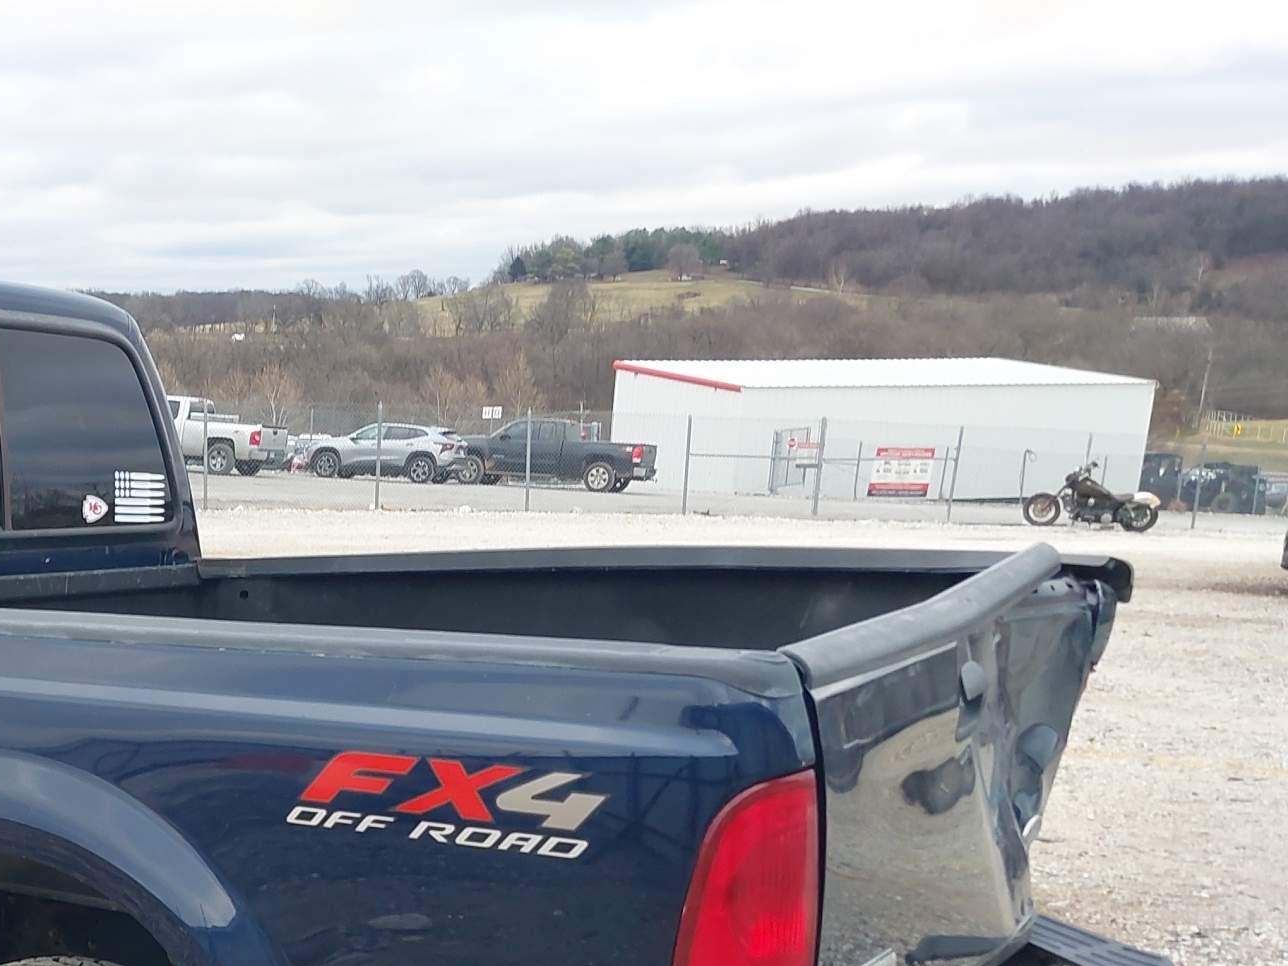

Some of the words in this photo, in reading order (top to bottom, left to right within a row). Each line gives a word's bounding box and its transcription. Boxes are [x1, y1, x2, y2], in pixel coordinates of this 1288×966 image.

[299, 751, 609, 831] FX4
[286, 806, 395, 833] OFF
[408, 820, 589, 859] ROAD
